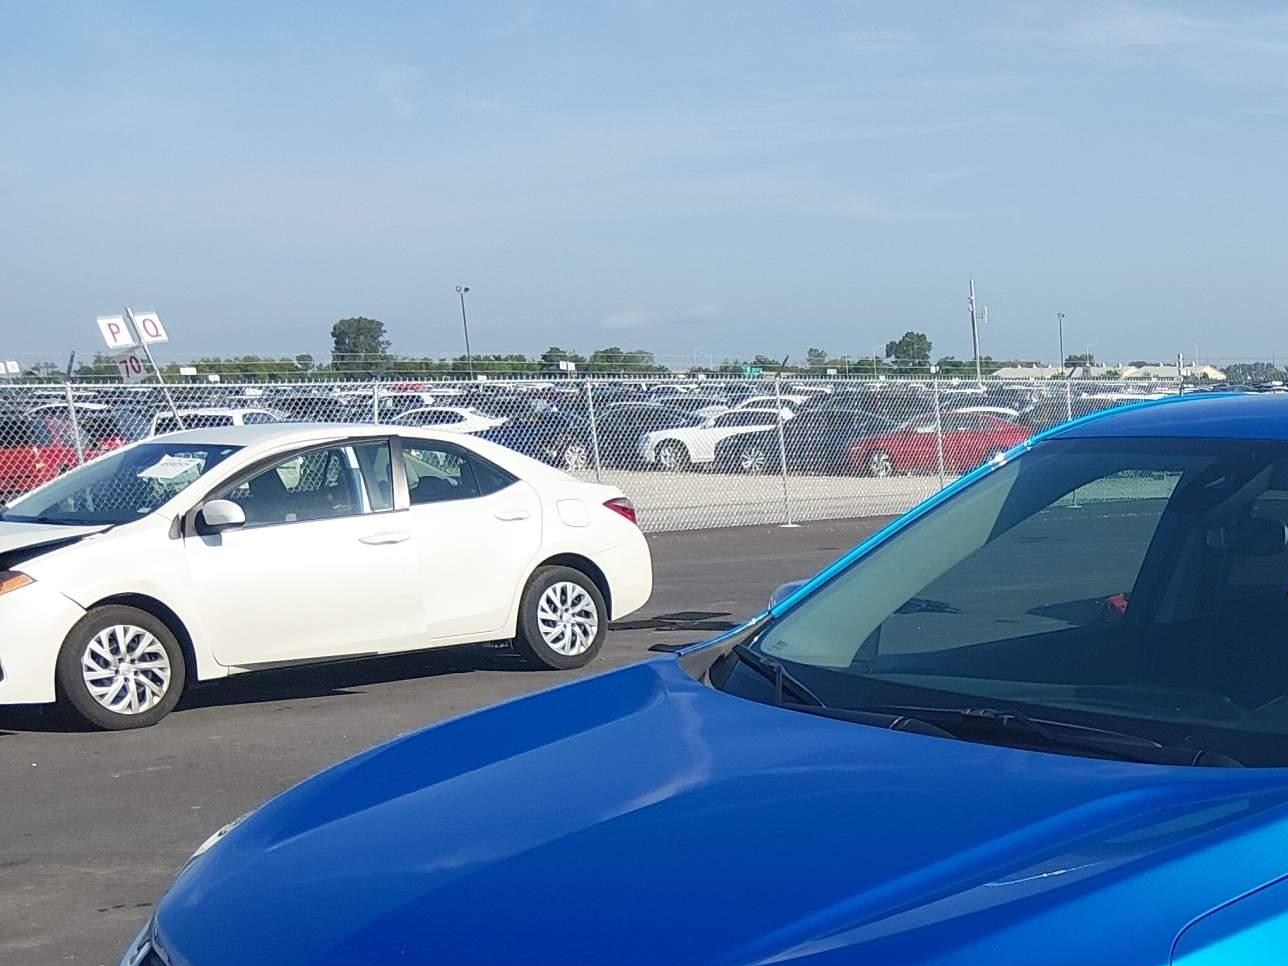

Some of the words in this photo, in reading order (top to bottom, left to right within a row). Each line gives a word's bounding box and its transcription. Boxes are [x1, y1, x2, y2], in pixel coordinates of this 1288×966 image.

[107, 322, 120, 343] P
[142, 318, 162, 338] Q
[119, 355, 141, 378] 70
